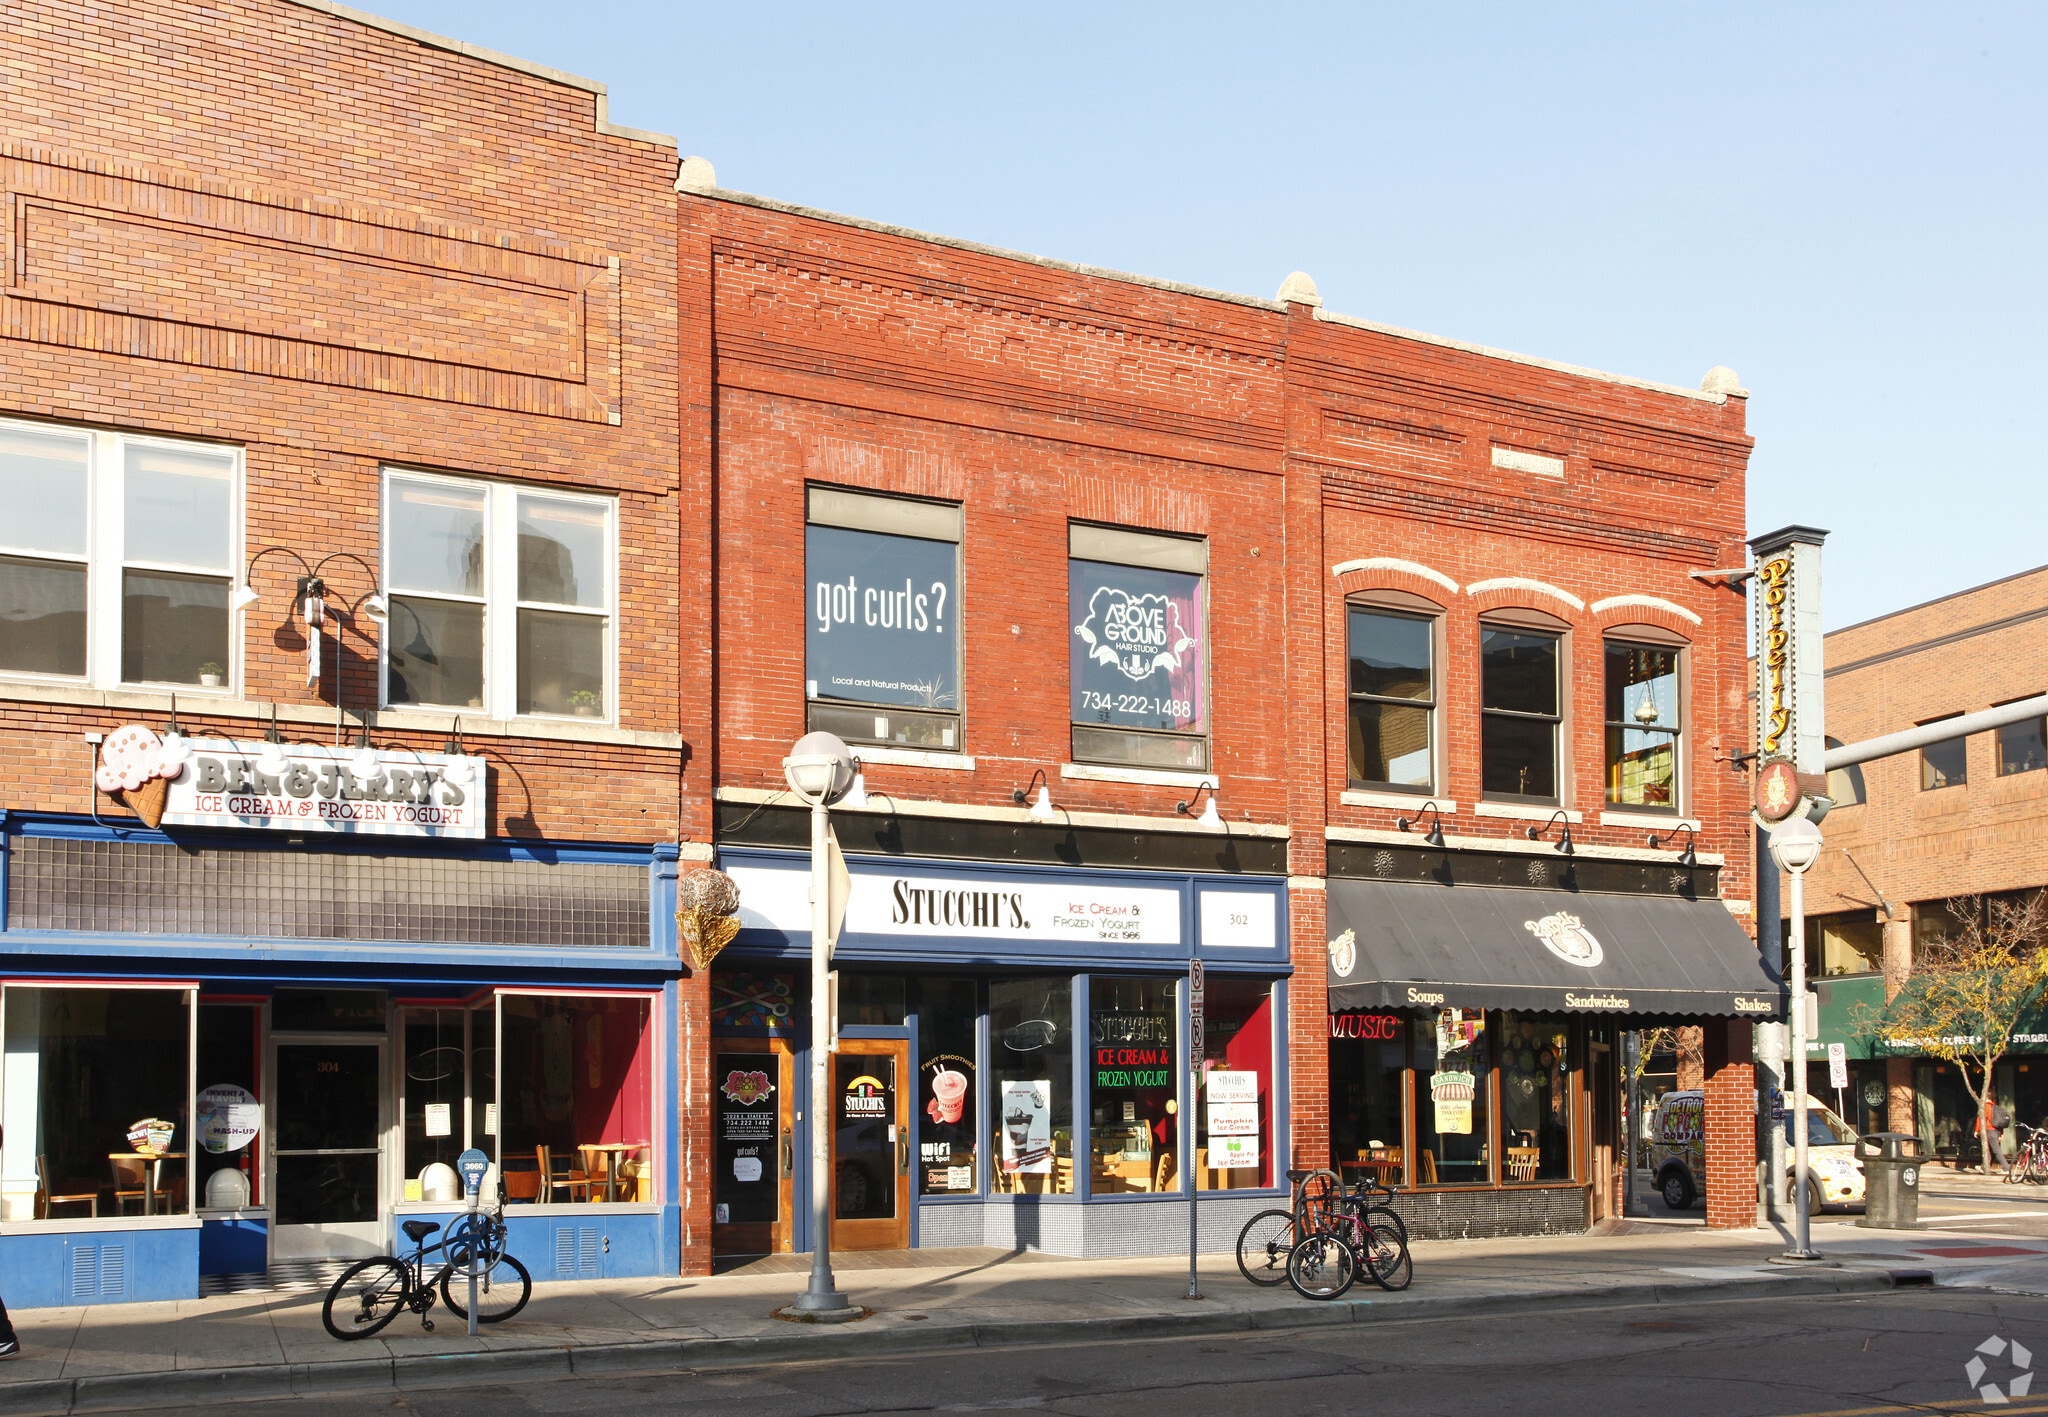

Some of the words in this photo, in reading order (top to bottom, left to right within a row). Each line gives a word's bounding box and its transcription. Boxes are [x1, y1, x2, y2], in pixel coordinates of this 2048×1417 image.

[816, 576, 857, 633] got
[864, 578, 947, 633] curls?
[1104, 603, 1164, 629] ABOVE
[1104, 622, 1167, 645] GROUND
[1115, 642, 1133, 652] HAIR
[1132, 644, 1158, 654] STUDIO
[1761, 558, 1789, 753] Potbelly
[832, 675, 853, 685] Local
[854, 677, 870, 687] and
[871, 678, 899, 690] Natural
[899, 682, 932, 693] Products
[1081, 690, 1191, 717] 734-222-1488
[194, 796, 223, 812] ICE
[228, 797, 293, 816] CREAM
[297, 802, 314, 816] &
[317, 802, 387, 820] FROZEN
[392, 804, 463, 824] YOGURT
[1068, 902, 1084, 914] ICE
[1089, 903, 1127, 916] CREAM
[1131, 905, 1140, 916] &
[1052, 915, 1095, 929] FROZEN
[1099, 918, 1140, 930] YOGURT
[1230, 913, 1248, 925] 302
[1099, 931, 1119, 939] SINCE
[1407, 987, 1445, 1006] Soups
[1565, 993, 1630, 1009] Sandwiches
[1734, 997, 1772, 1011] Shakes
[1328, 1014, 1396, 1039] MUSIC
[920, 1056, 940, 1072] FRUIT
[940, 1054, 976, 1071] SMOOTHIES
[1097, 1048, 1114, 1065] ICE
[1117, 1048, 1157, 1065] CREAM
[1160, 1048, 1169, 1065] &
[317, 1062, 341, 1073] 304
[1439, 1061, 1468, 1072] PIZZA
[1097, 1070, 1131, 1087] FROZEN
[1133, 1070, 1168, 1087] YOGURT
[1434, 1074, 1471, 1085] SANDWICH
[921, 1155, 934, 1163] Hot
[935, 1155, 950, 1163] Spot
[1229, 1151, 1245, 1159] Apple
[465, 1162, 484, 1170] 3660
